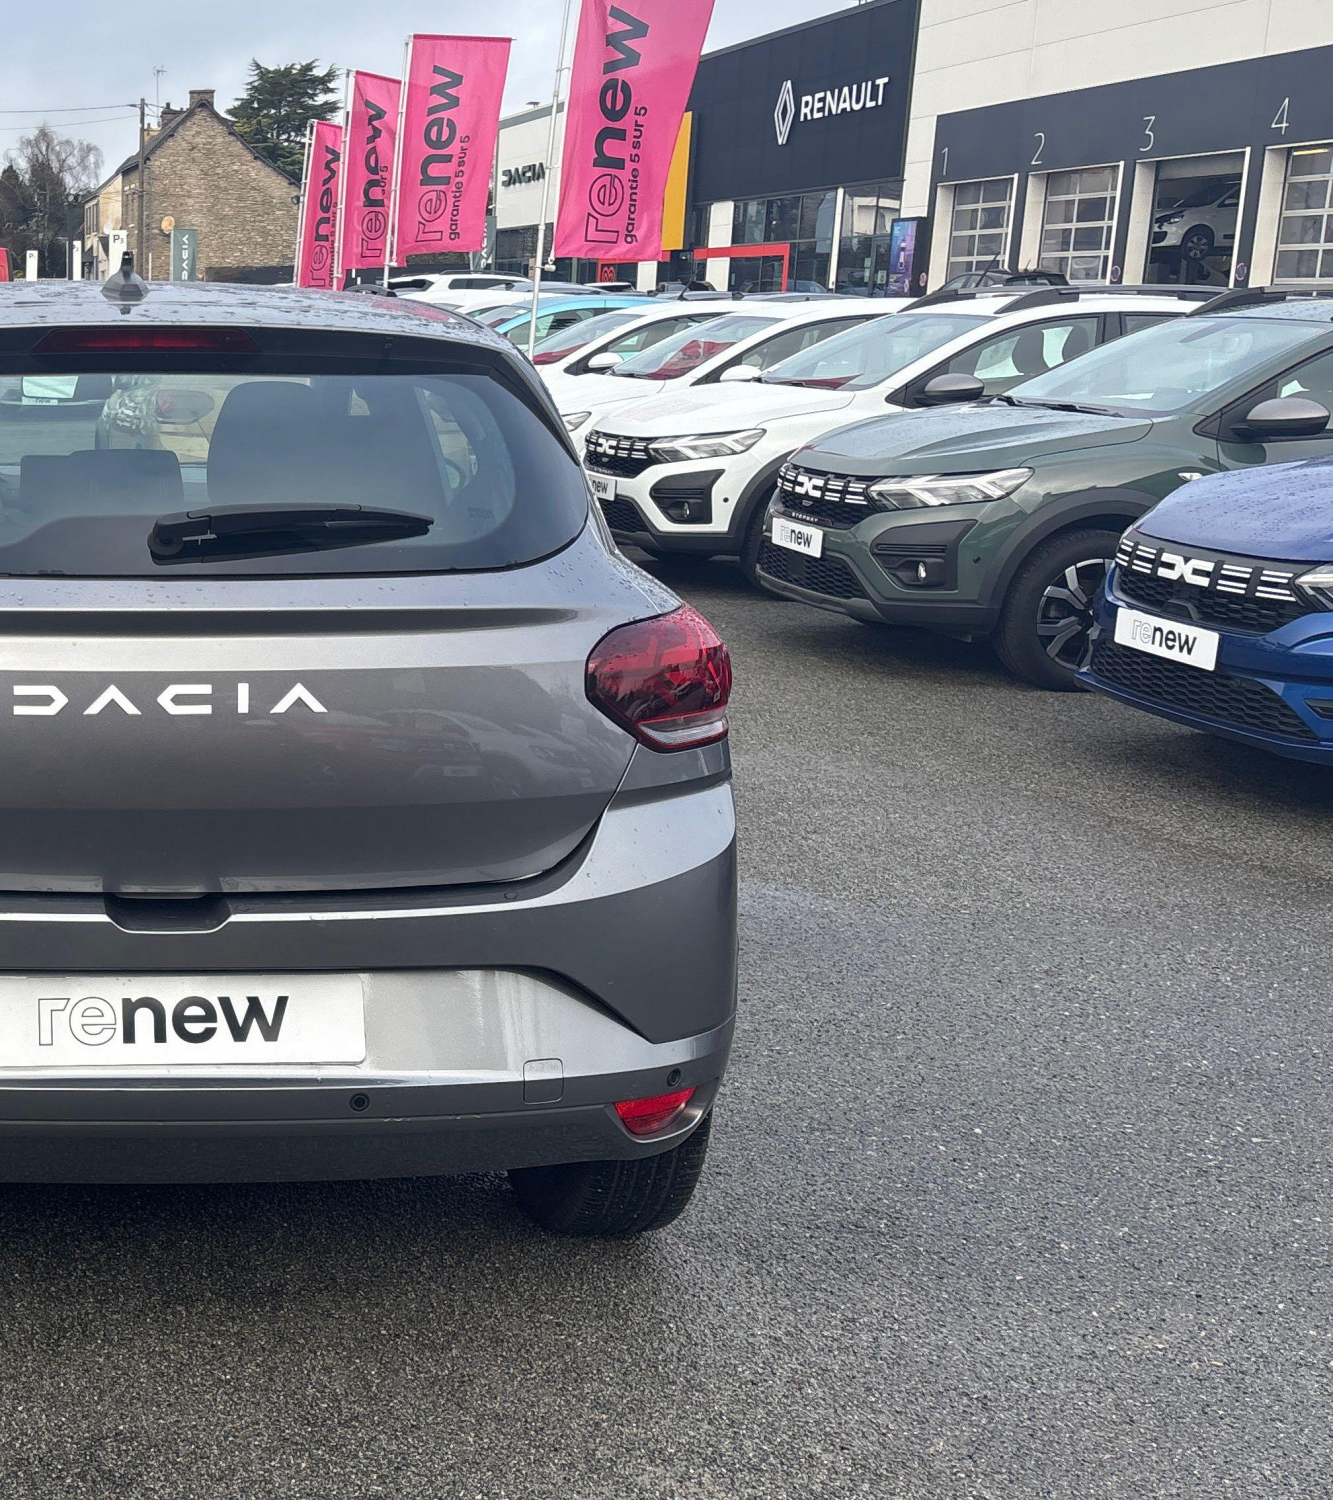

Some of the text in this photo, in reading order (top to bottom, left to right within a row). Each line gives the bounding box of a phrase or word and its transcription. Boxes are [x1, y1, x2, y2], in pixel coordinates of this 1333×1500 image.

[800, 77, 889, 121] RENAULT
[1271, 97, 1290, 135] 4
[585, 4, 649, 244] renew
[1139, 116, 1155, 151] 3
[415, 65, 464, 242] renew
[941, 147, 949, 175] 1
[1031, 132, 1045, 165] 2
[448, 135, 470, 241] garantie 5 sur 5
[501, 162, 546, 187] DACIA
[624, 106, 647, 245] garantie 5 sur 5
[307, 145, 341, 287] renew
[181, 234, 189, 280] DACIA
[779, 525, 812, 548] renew
[1131, 619, 1197, 655] renew
[13, 682, 328, 716] DACIA
[37, 994, 290, 1047] renew
